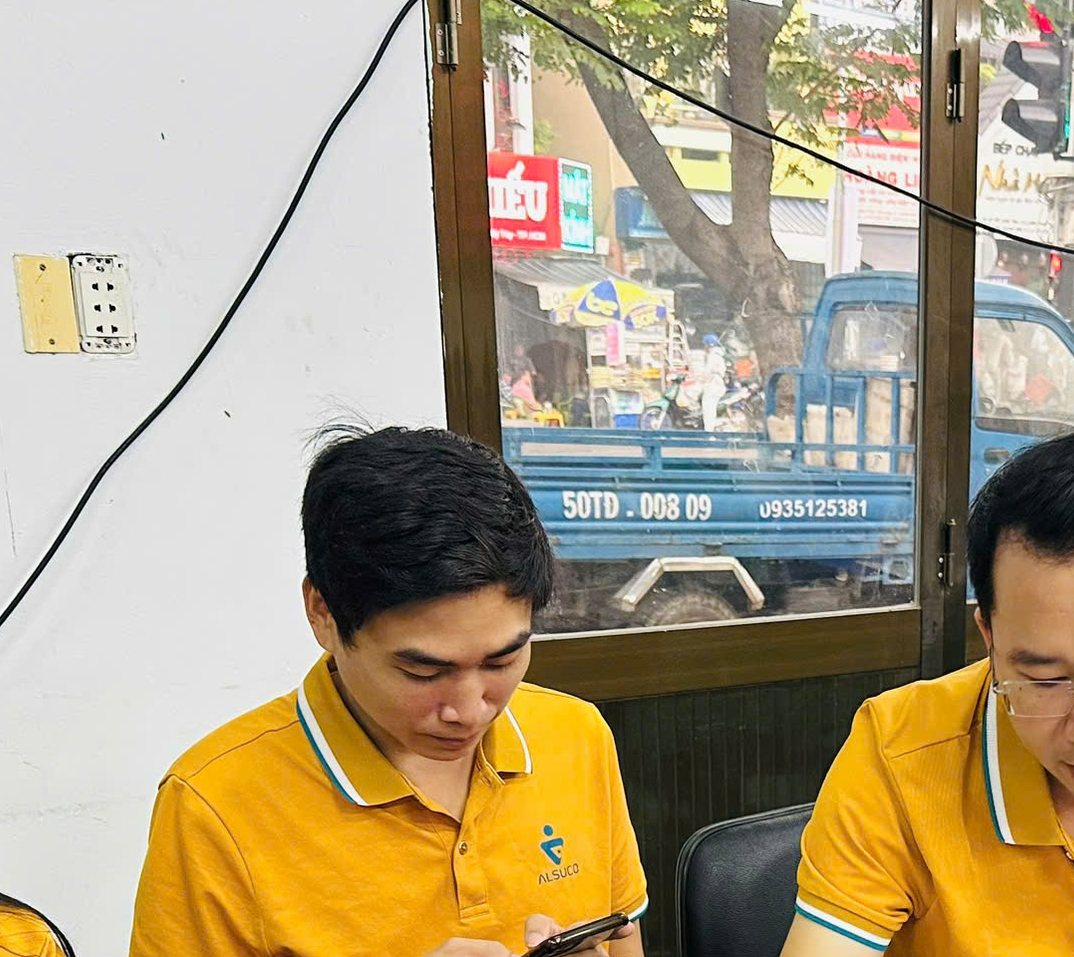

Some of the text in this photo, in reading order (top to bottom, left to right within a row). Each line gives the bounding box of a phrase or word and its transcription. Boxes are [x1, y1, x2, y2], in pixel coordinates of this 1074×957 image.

[640, 492, 680, 520] 008
[686, 493, 712, 520] 09
[759, 499, 867, 519] 0935125381
[538, 863, 579, 885] ALSUCO
